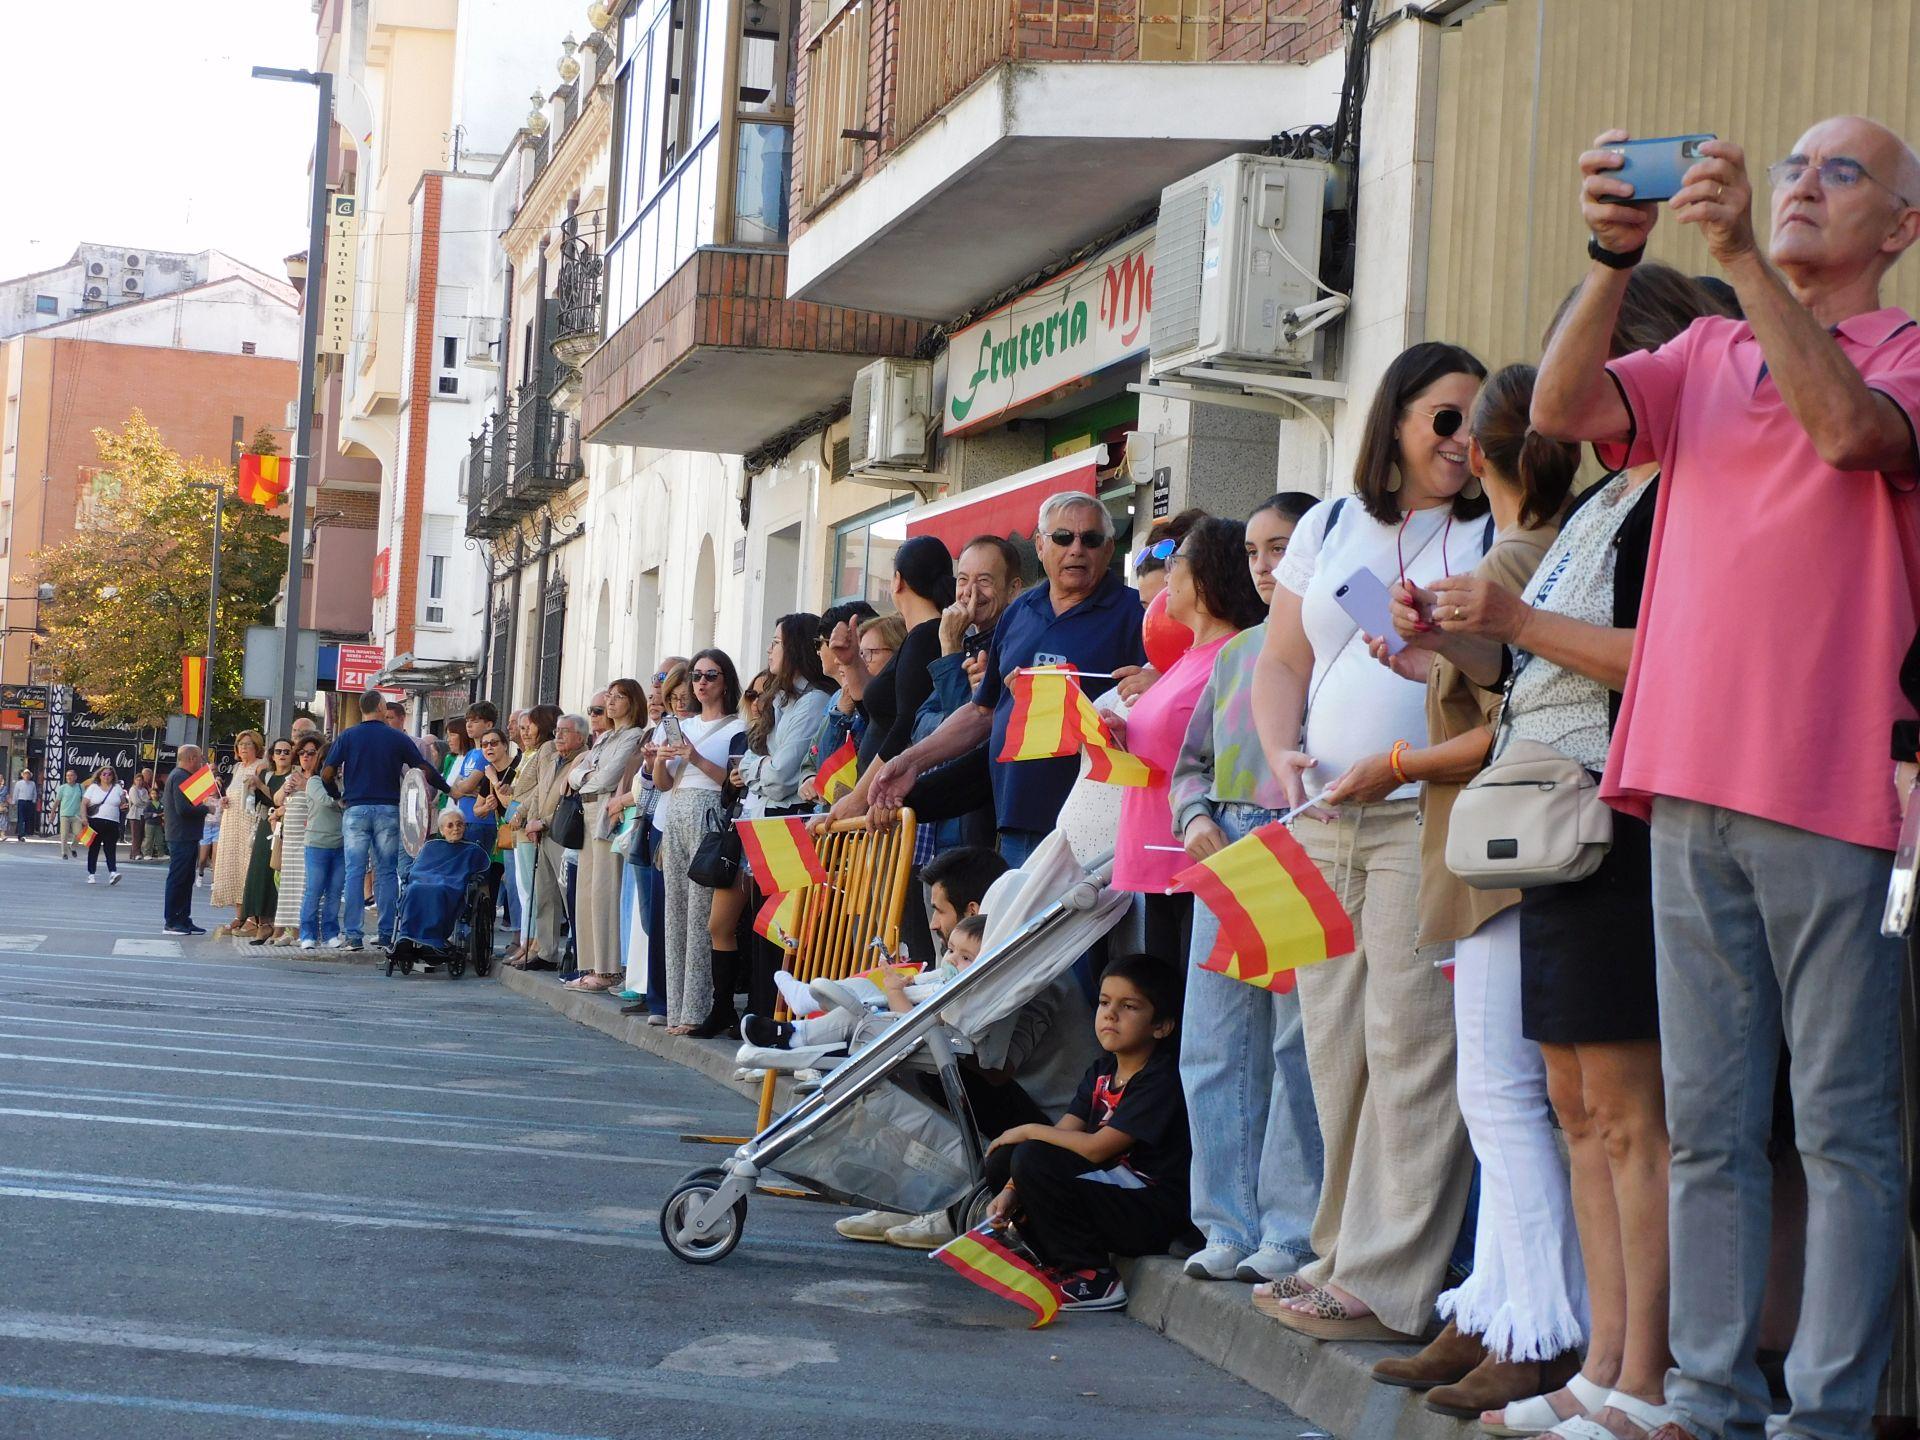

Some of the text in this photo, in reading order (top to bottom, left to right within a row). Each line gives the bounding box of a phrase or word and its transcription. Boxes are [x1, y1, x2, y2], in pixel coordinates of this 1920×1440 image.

[333, 294, 347, 350] Dental
[67, 746, 134, 772] Compro Oro
